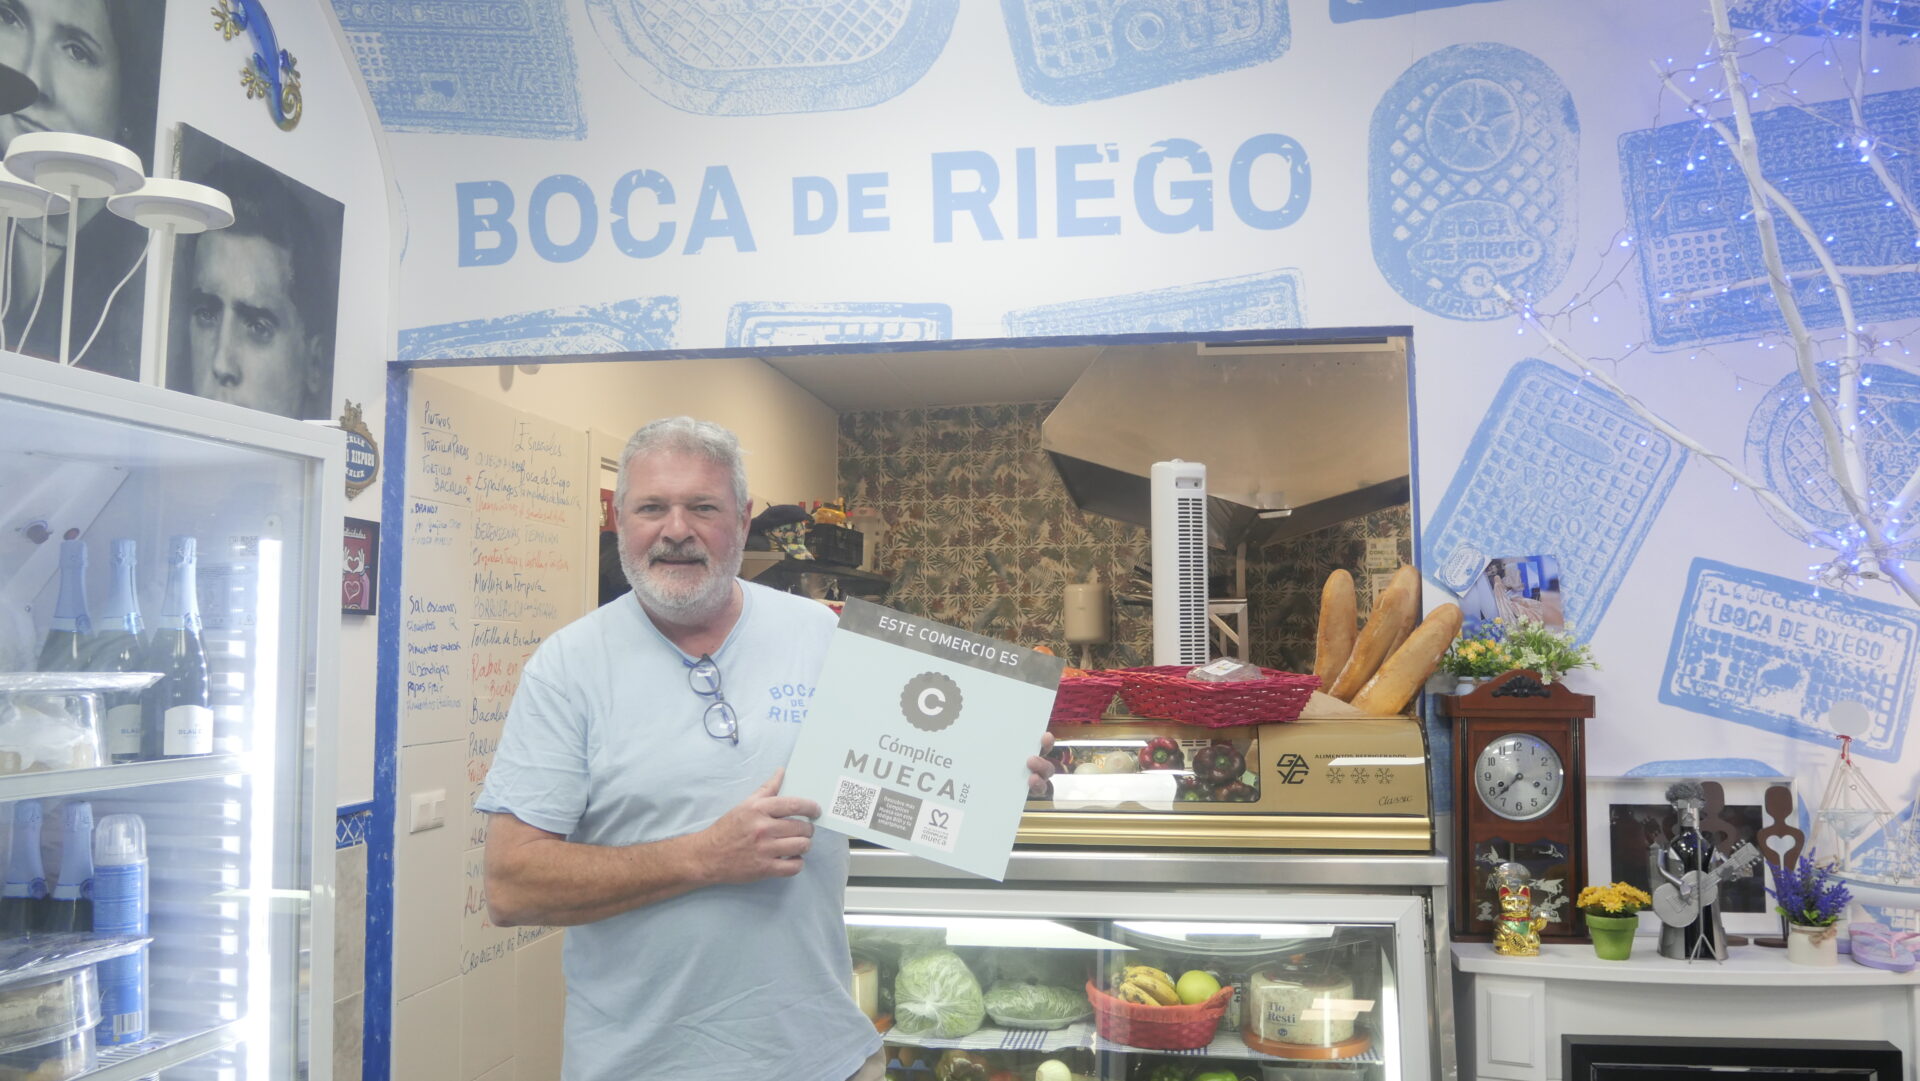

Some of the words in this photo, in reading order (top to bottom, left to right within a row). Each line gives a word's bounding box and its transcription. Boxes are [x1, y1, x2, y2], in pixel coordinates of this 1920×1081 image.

[455, 165, 757, 268] BOCA
[791, 172, 891, 236] DE
[931, 133, 1312, 244] RIEGO
[1719, 603, 1773, 634] BOCA
[1777, 618, 1809, 642] DE
[1813, 626, 1884, 661] RIEGO
[878, 615, 917, 637] ESTE
[919, 627, 997, 660] COMERCIO
[999, 650, 1020, 666] ES
[790, 699, 805, 708] DE
[917, 687, 946, 716] C
[767, 705, 809, 724] RIE
[878, 733, 954, 769] Cómplice
[1499, 746, 1506, 756] 11
[1513, 742, 1523, 752] 12
[1487, 757, 1496, 767] 10
[1541, 757, 1548, 767] 2
[843, 748, 956, 801] MUECA
[1484, 772, 1492, 781] 9
[1546, 772, 1552, 781] 3
[959, 783, 971, 804] 2025
[1488, 786, 1496, 796] 8
[1541, 787, 1548, 796] 4
[1500, 797, 1507, 807] 7
[1515, 802, 1523, 811] 6
[1530, 798, 1538, 807] 5
[1268, 1011, 1297, 1024] Resti
